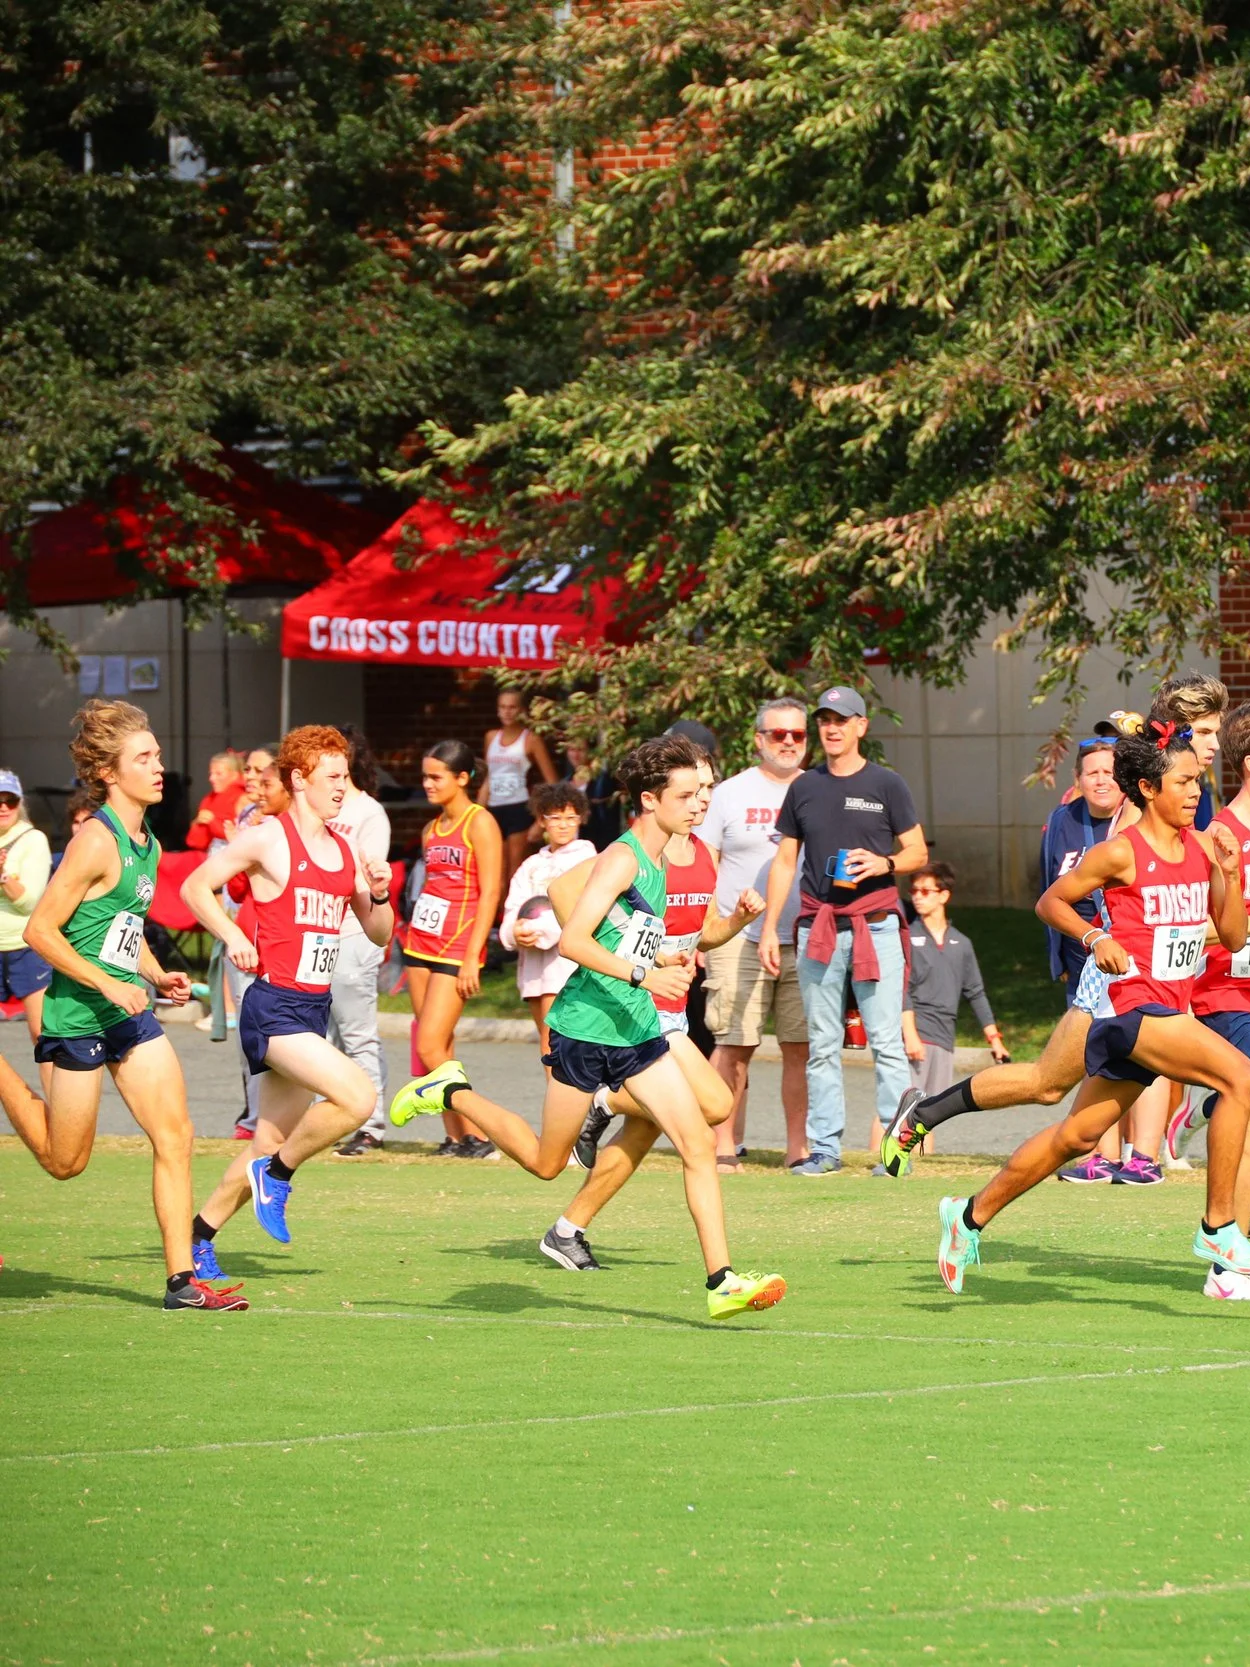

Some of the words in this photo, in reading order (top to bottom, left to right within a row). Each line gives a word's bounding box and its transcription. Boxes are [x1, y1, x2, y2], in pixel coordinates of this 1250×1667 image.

[308, 615, 411, 653] CROSS
[417, 620, 562, 660] COUNTRY
[1166, 937, 1203, 969] 1361
